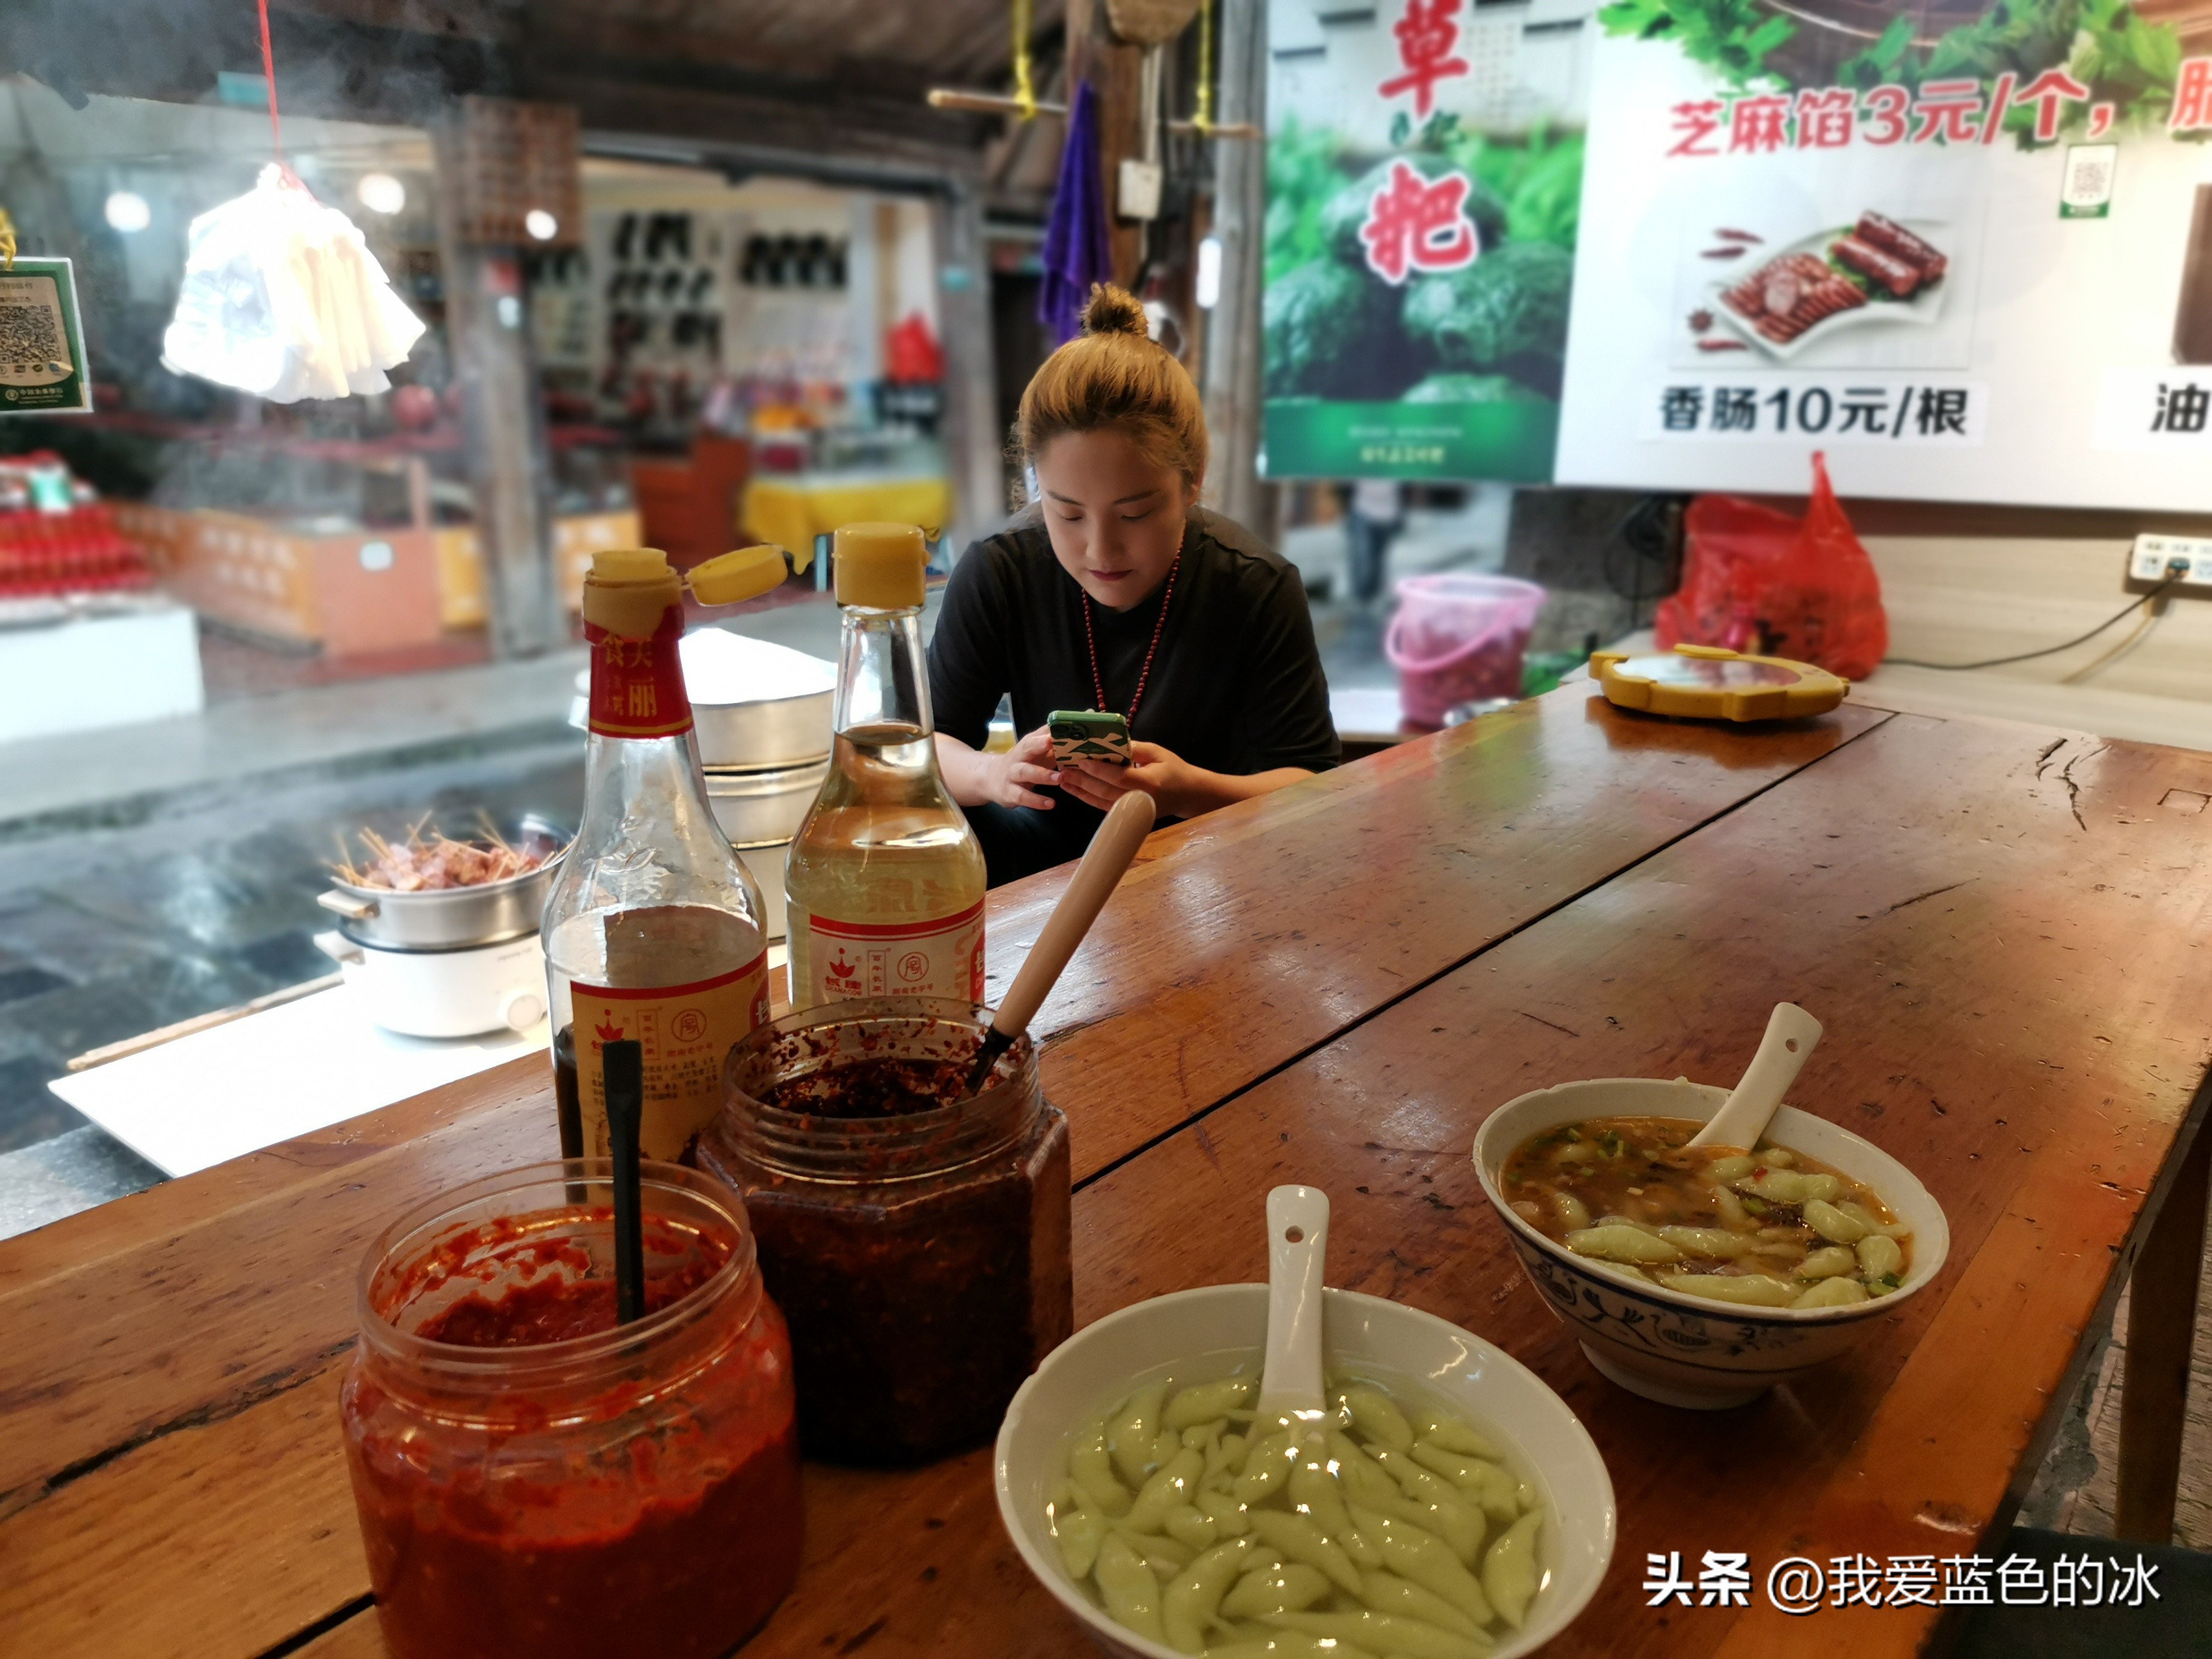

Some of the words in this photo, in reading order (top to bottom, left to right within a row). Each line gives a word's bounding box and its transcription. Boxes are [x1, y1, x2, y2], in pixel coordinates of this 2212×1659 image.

[1659, 385, 1970, 438] 香肠10元/根
[2150, 382, 2211, 432] 油
